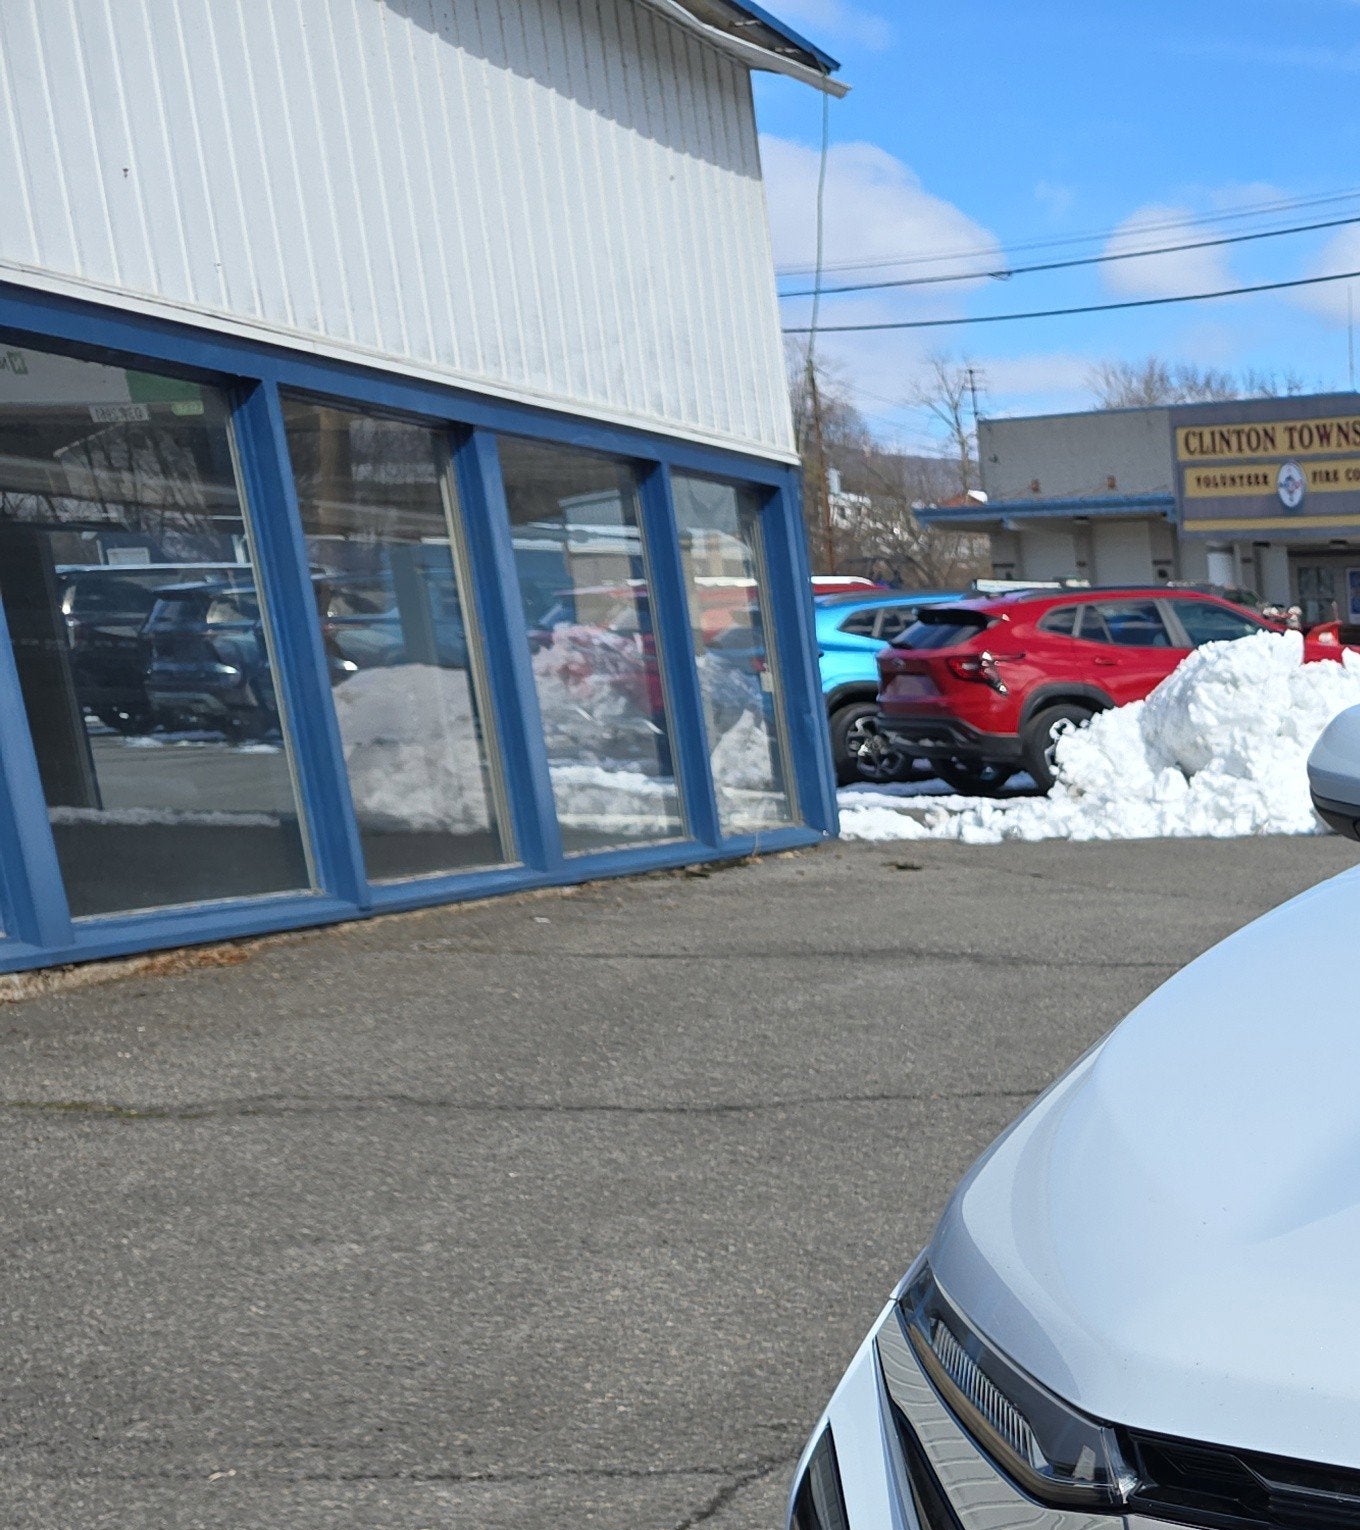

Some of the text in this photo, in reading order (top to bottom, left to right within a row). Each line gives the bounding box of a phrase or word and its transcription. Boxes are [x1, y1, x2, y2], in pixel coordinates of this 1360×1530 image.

[1184, 425, 1277, 456] CLINTON
[1194, 471, 1270, 488] VOLUNTEER
[1310, 468, 1340, 485] FIRE
